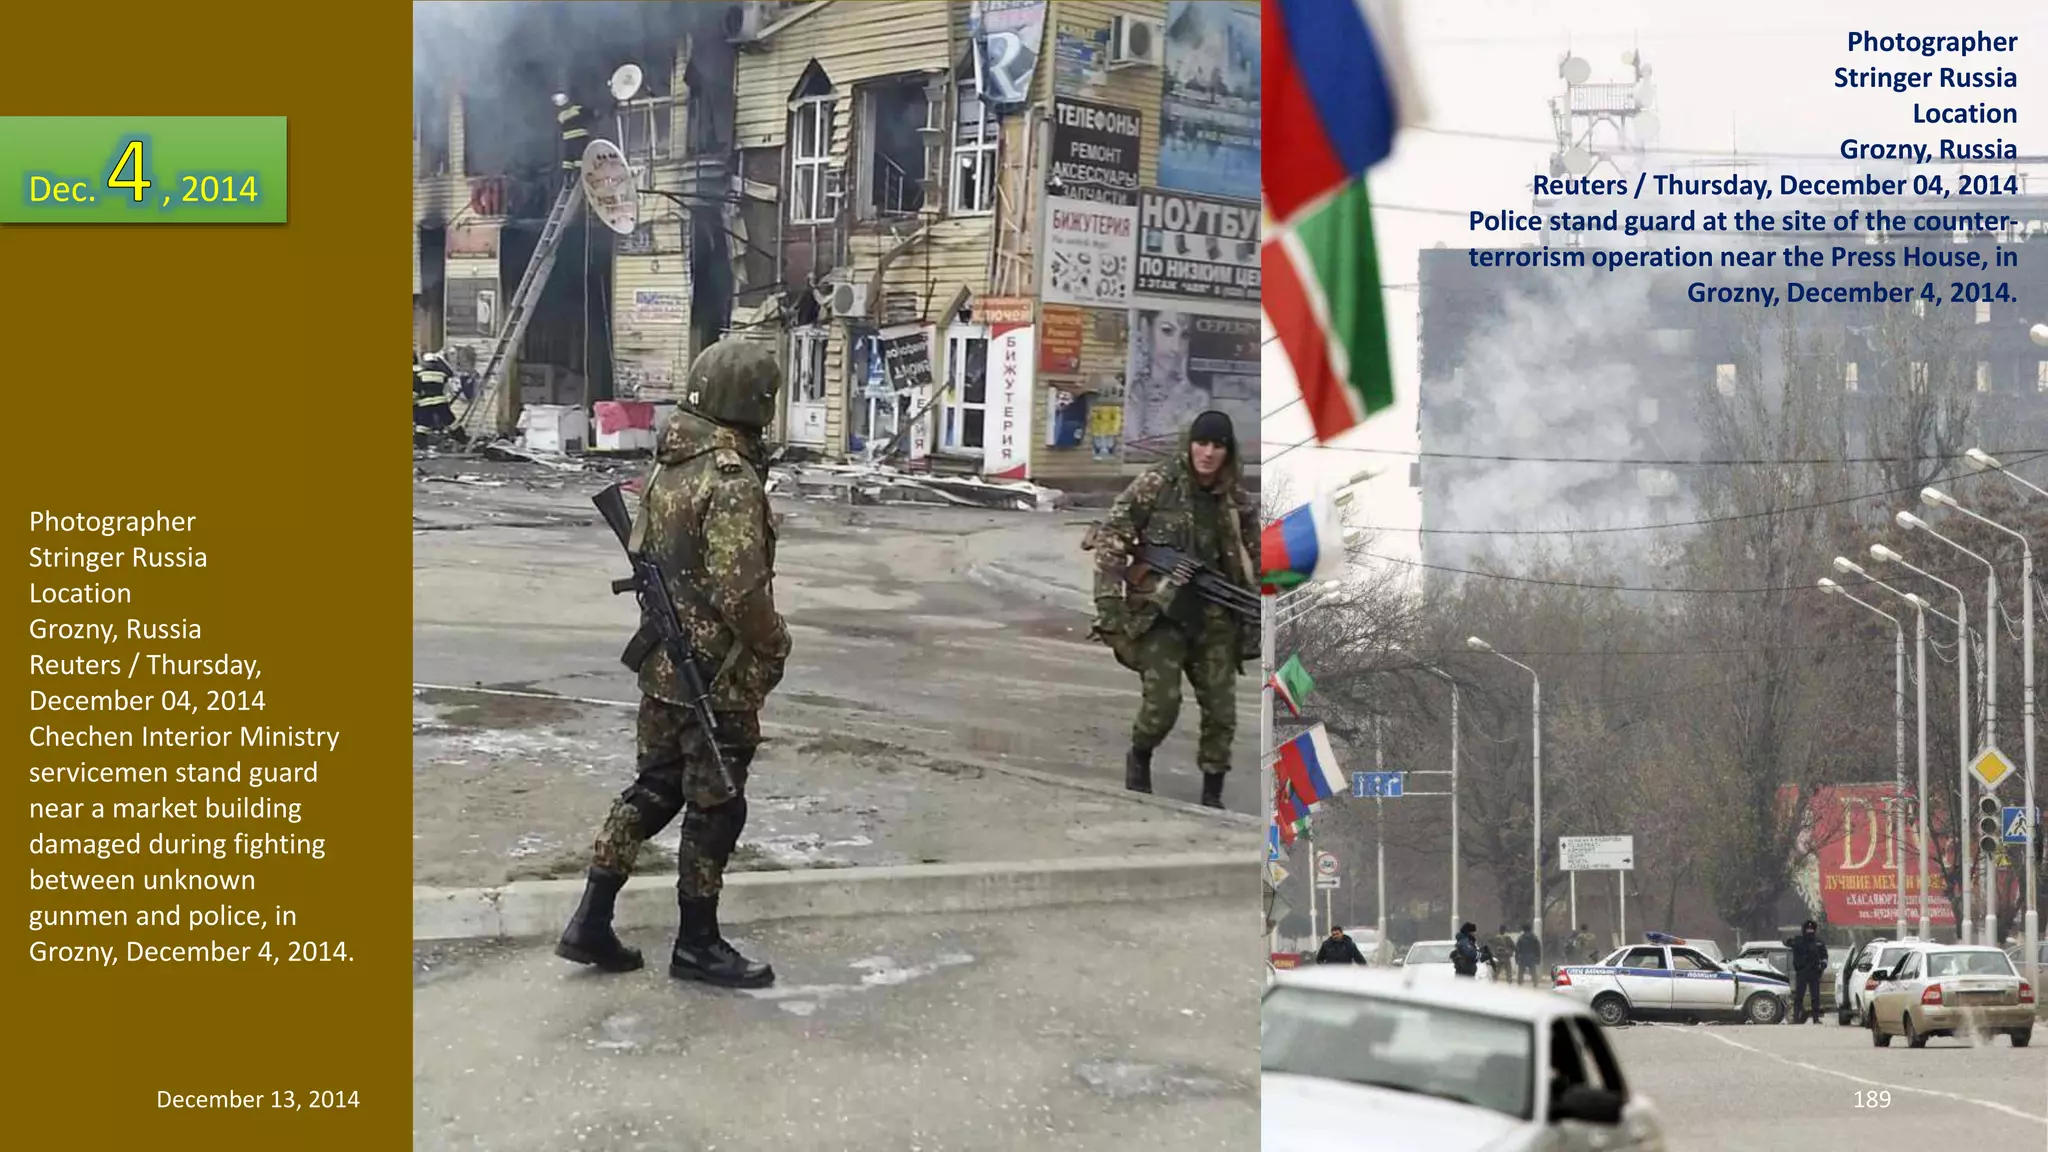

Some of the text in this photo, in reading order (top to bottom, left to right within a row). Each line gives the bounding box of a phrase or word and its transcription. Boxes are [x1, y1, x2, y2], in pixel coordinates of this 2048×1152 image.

[1056, 103, 1140, 137] ТЕЛЕФОНЫ
[1070, 141, 1122, 164] РЕМОНТ
[1052, 161, 1137, 189] АКСЕССУАРЫ
[1052, 209, 1131, 237] БИЖУТЕРИЯ
[1142, 193, 1261, 241] НОУТБУ
[1140, 257, 1164, 276] ПО
[1166, 260, 1233, 284] НИЗКИМ
[1002, 336, 1017, 459] БИЖУТЕРИЯ
[1825, 874, 1870, 890] ЛУЧШИЕ
[1872, 874, 1902, 890] МЕХ
